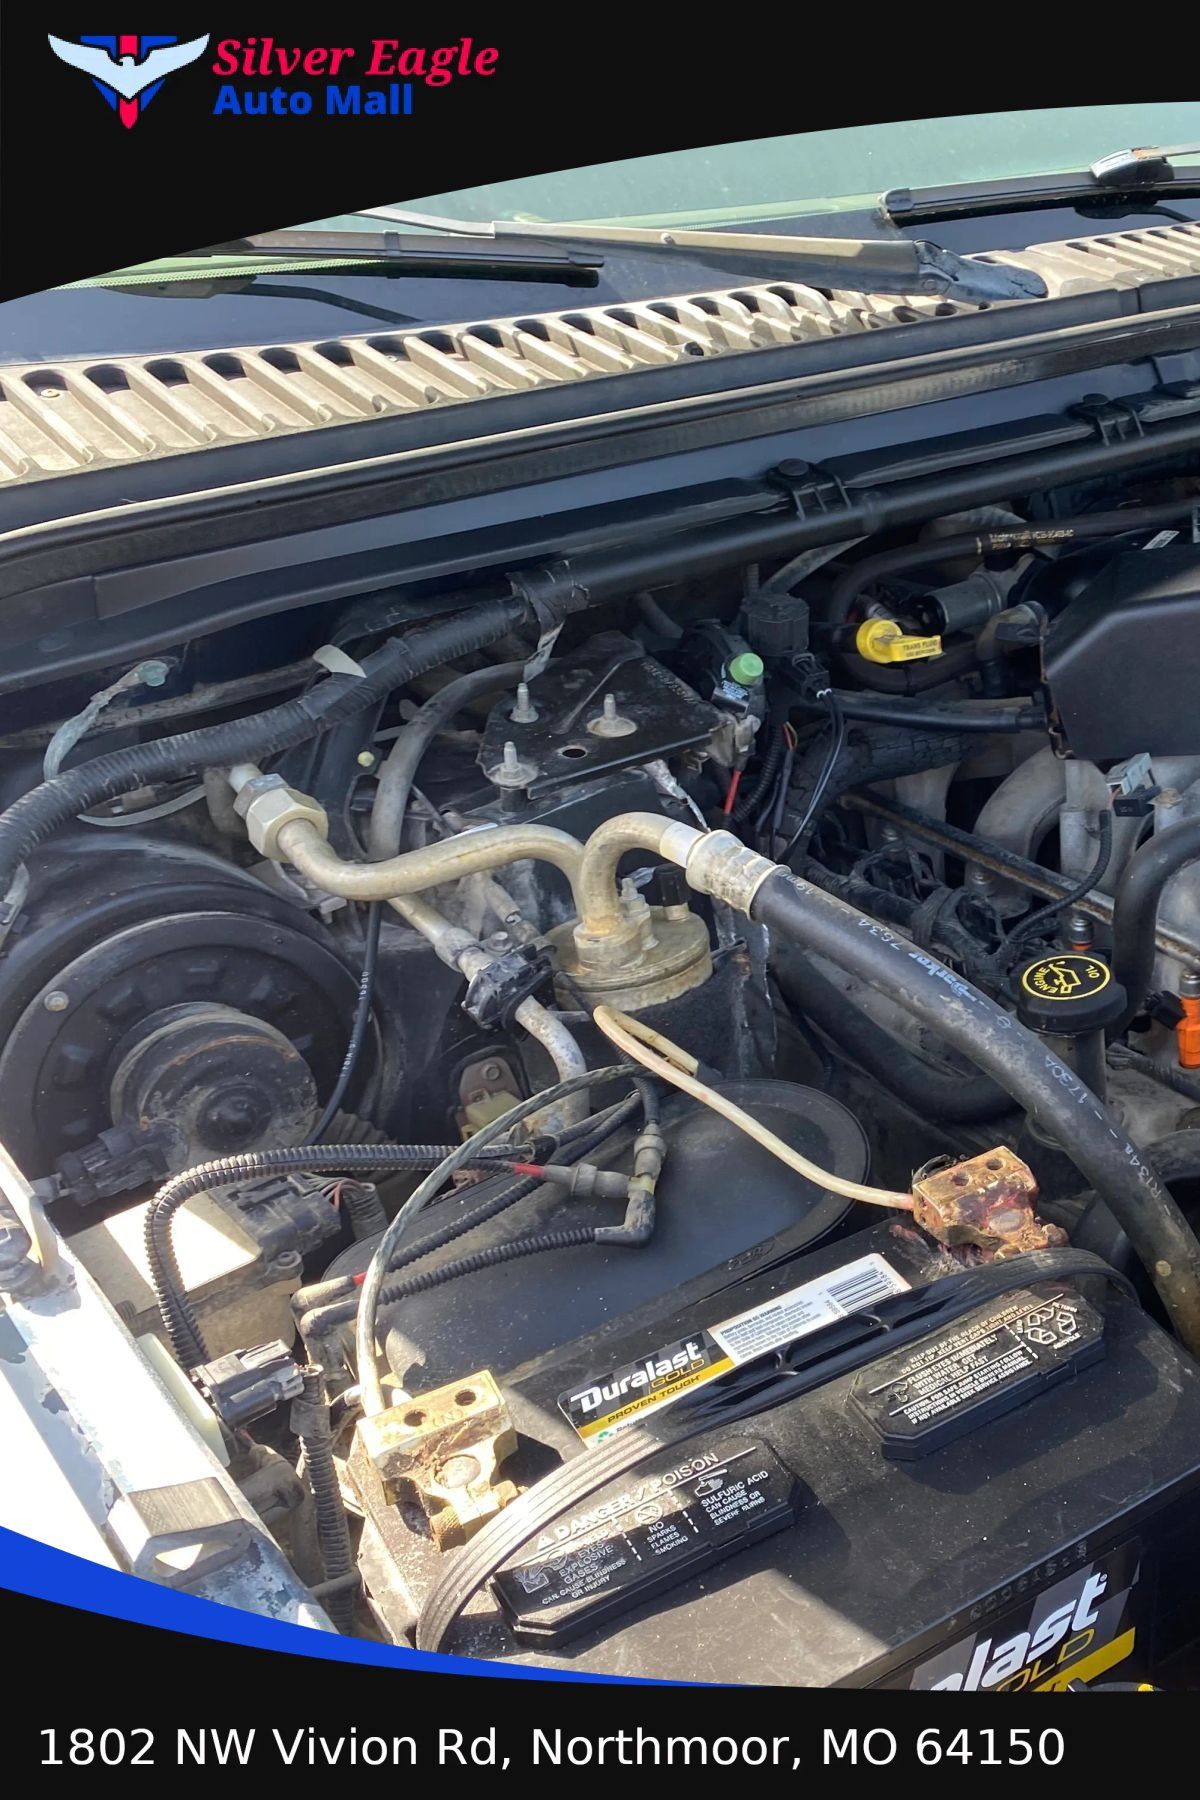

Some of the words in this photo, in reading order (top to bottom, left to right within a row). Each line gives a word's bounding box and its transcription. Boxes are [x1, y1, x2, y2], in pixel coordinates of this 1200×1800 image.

[1034, 966, 1058, 993] ENGINE
[1085, 965, 1100, 979] OIL
[570, 1340, 703, 1414] Duralast
[650, 1358, 705, 1388] GOLD
[907, 1368, 932, 1383] FLUSH
[931, 1358, 951, 1371] EYES
[912, 1376, 933, 1388] WITH
[961, 1353, 976, 1364] GET
[917, 1376, 951, 1394] MEDICAL
[950, 1365, 968, 1378] HELP
[969, 1355, 988, 1368] FAST
[607, 1396, 657, 1423] PROVEN
[659, 1374, 700, 1398] TOUGH
[554, 1495, 635, 1540] DANGER
[652, 1453, 719, 1493] POISON
[701, 1480, 745, 1507] SULFURIC
[747, 1470, 769, 1486] ACID
[705, 1502, 721, 1512] CAN
[722, 1489, 746, 1504] CAUSE
[710, 1497, 748, 1518] BLINDNESS
[748, 1490, 760, 1499] OR
[646, 1524, 676, 1542] SPARKS
[648, 1521, 663, 1532] NO
[650, 1531, 679, 1548] FLAMES
[577, 1540, 603, 1557] EYES
[655, 1535, 688, 1554] SMOKING
[559, 1579, 584, 1595] CAUSE
[585, 1558, 625, 1582] BLINDNESS
[564, 1563, 598, 1583] GASES
[571, 1588, 583, 1597] OR
[584, 1574, 609, 1591] INJURY
